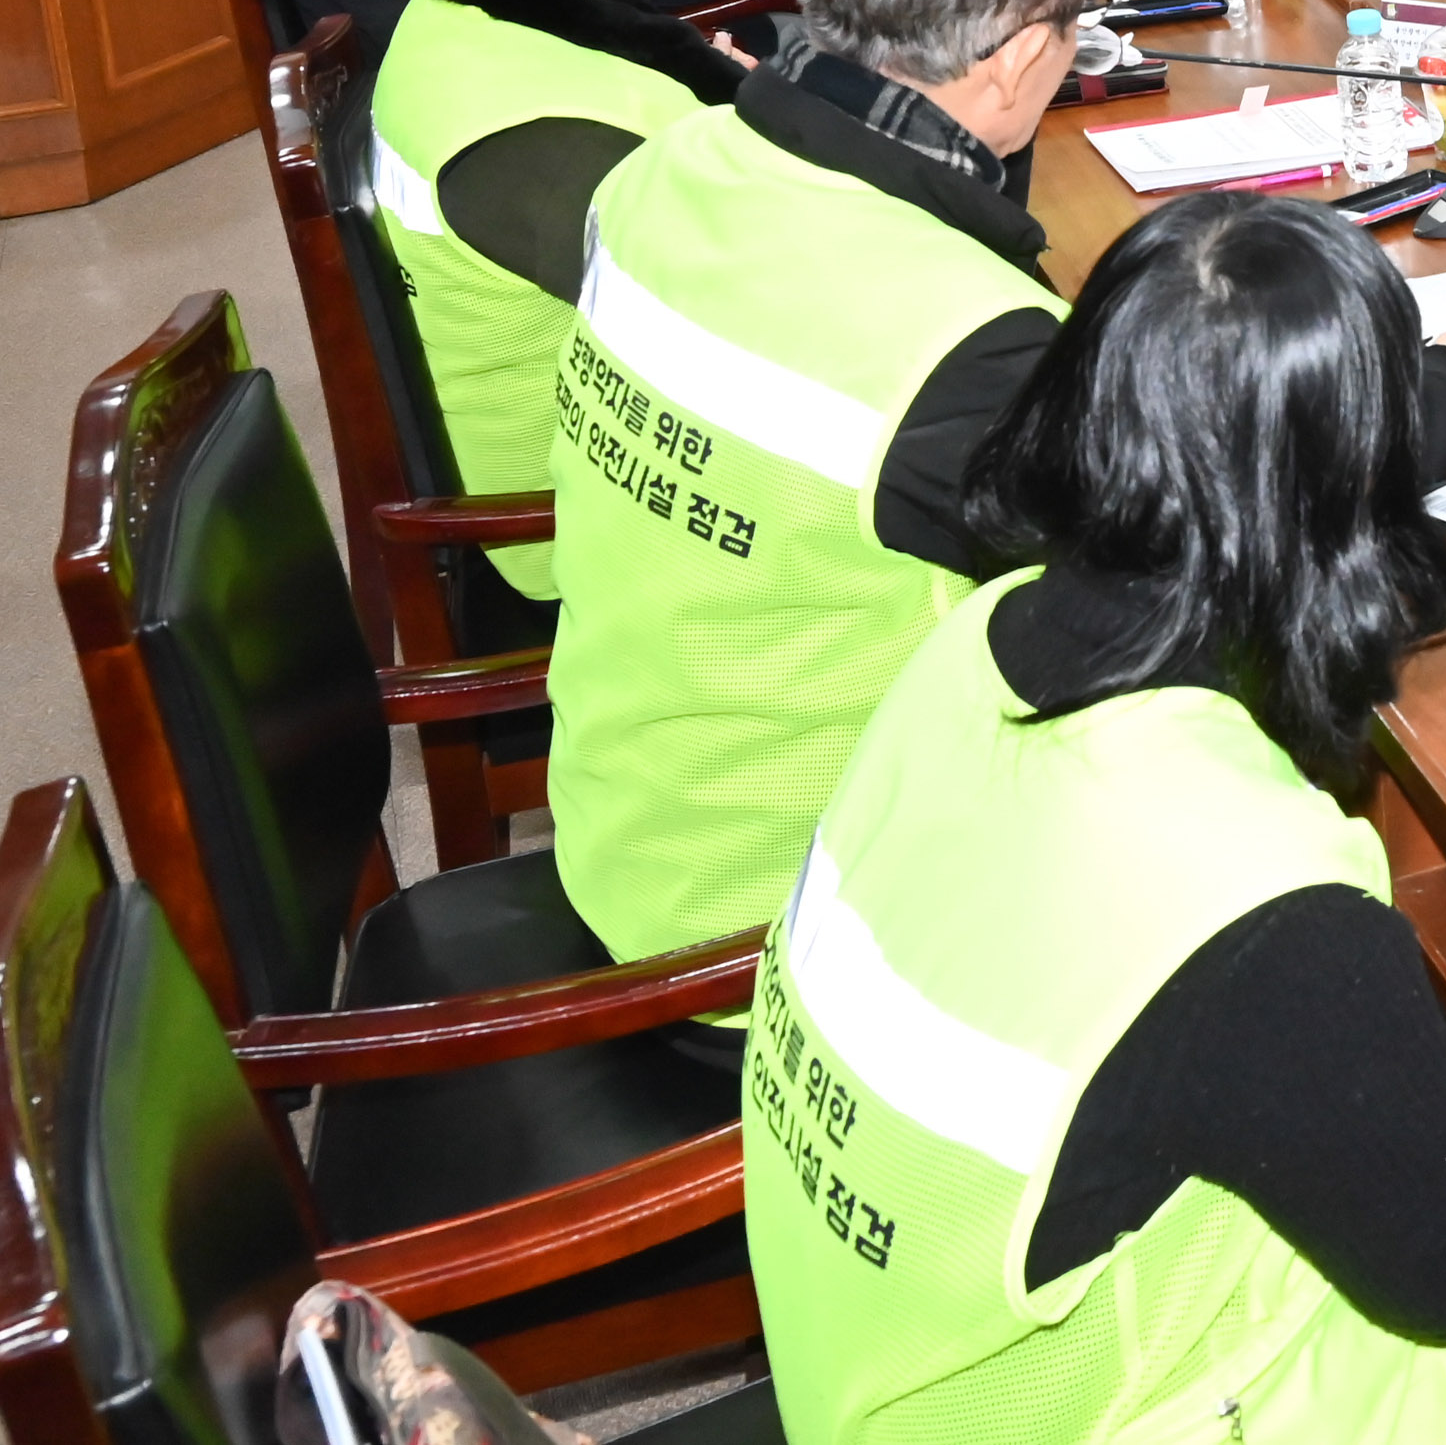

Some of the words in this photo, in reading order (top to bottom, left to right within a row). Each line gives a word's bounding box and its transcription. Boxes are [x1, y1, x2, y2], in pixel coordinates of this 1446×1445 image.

[569, 327, 650, 437] 보행약자를
[653, 411, 713, 476] 위한
[587, 422, 678, 521] 안전시설
[687, 492, 757, 559] 점검
[753, 1051, 823, 1206] 안전시설
[827, 1173, 895, 1270] 점검
[806, 1057, 857, 1151] 위한
